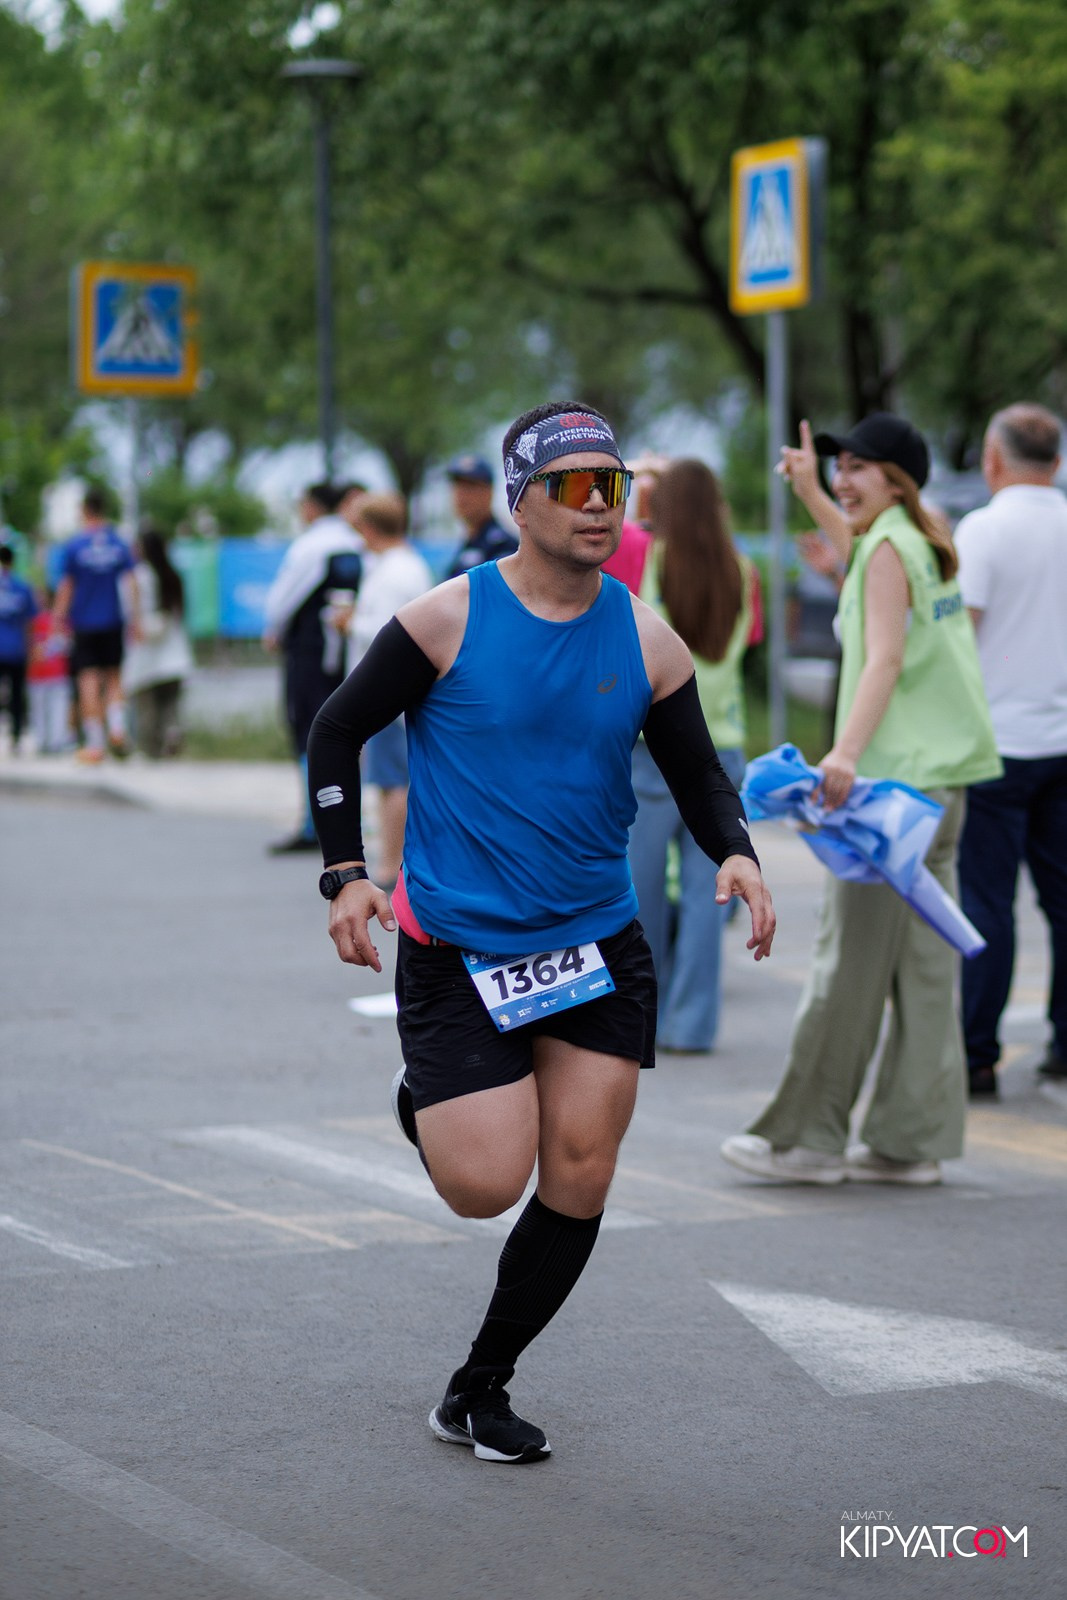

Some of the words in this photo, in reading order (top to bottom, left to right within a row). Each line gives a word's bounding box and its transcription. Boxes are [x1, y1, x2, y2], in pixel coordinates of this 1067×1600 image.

[560, 432, 606, 443] АТЛЕТИКА
[469, 954, 479, 965] 5
[490, 946, 586, 1001] 1364
